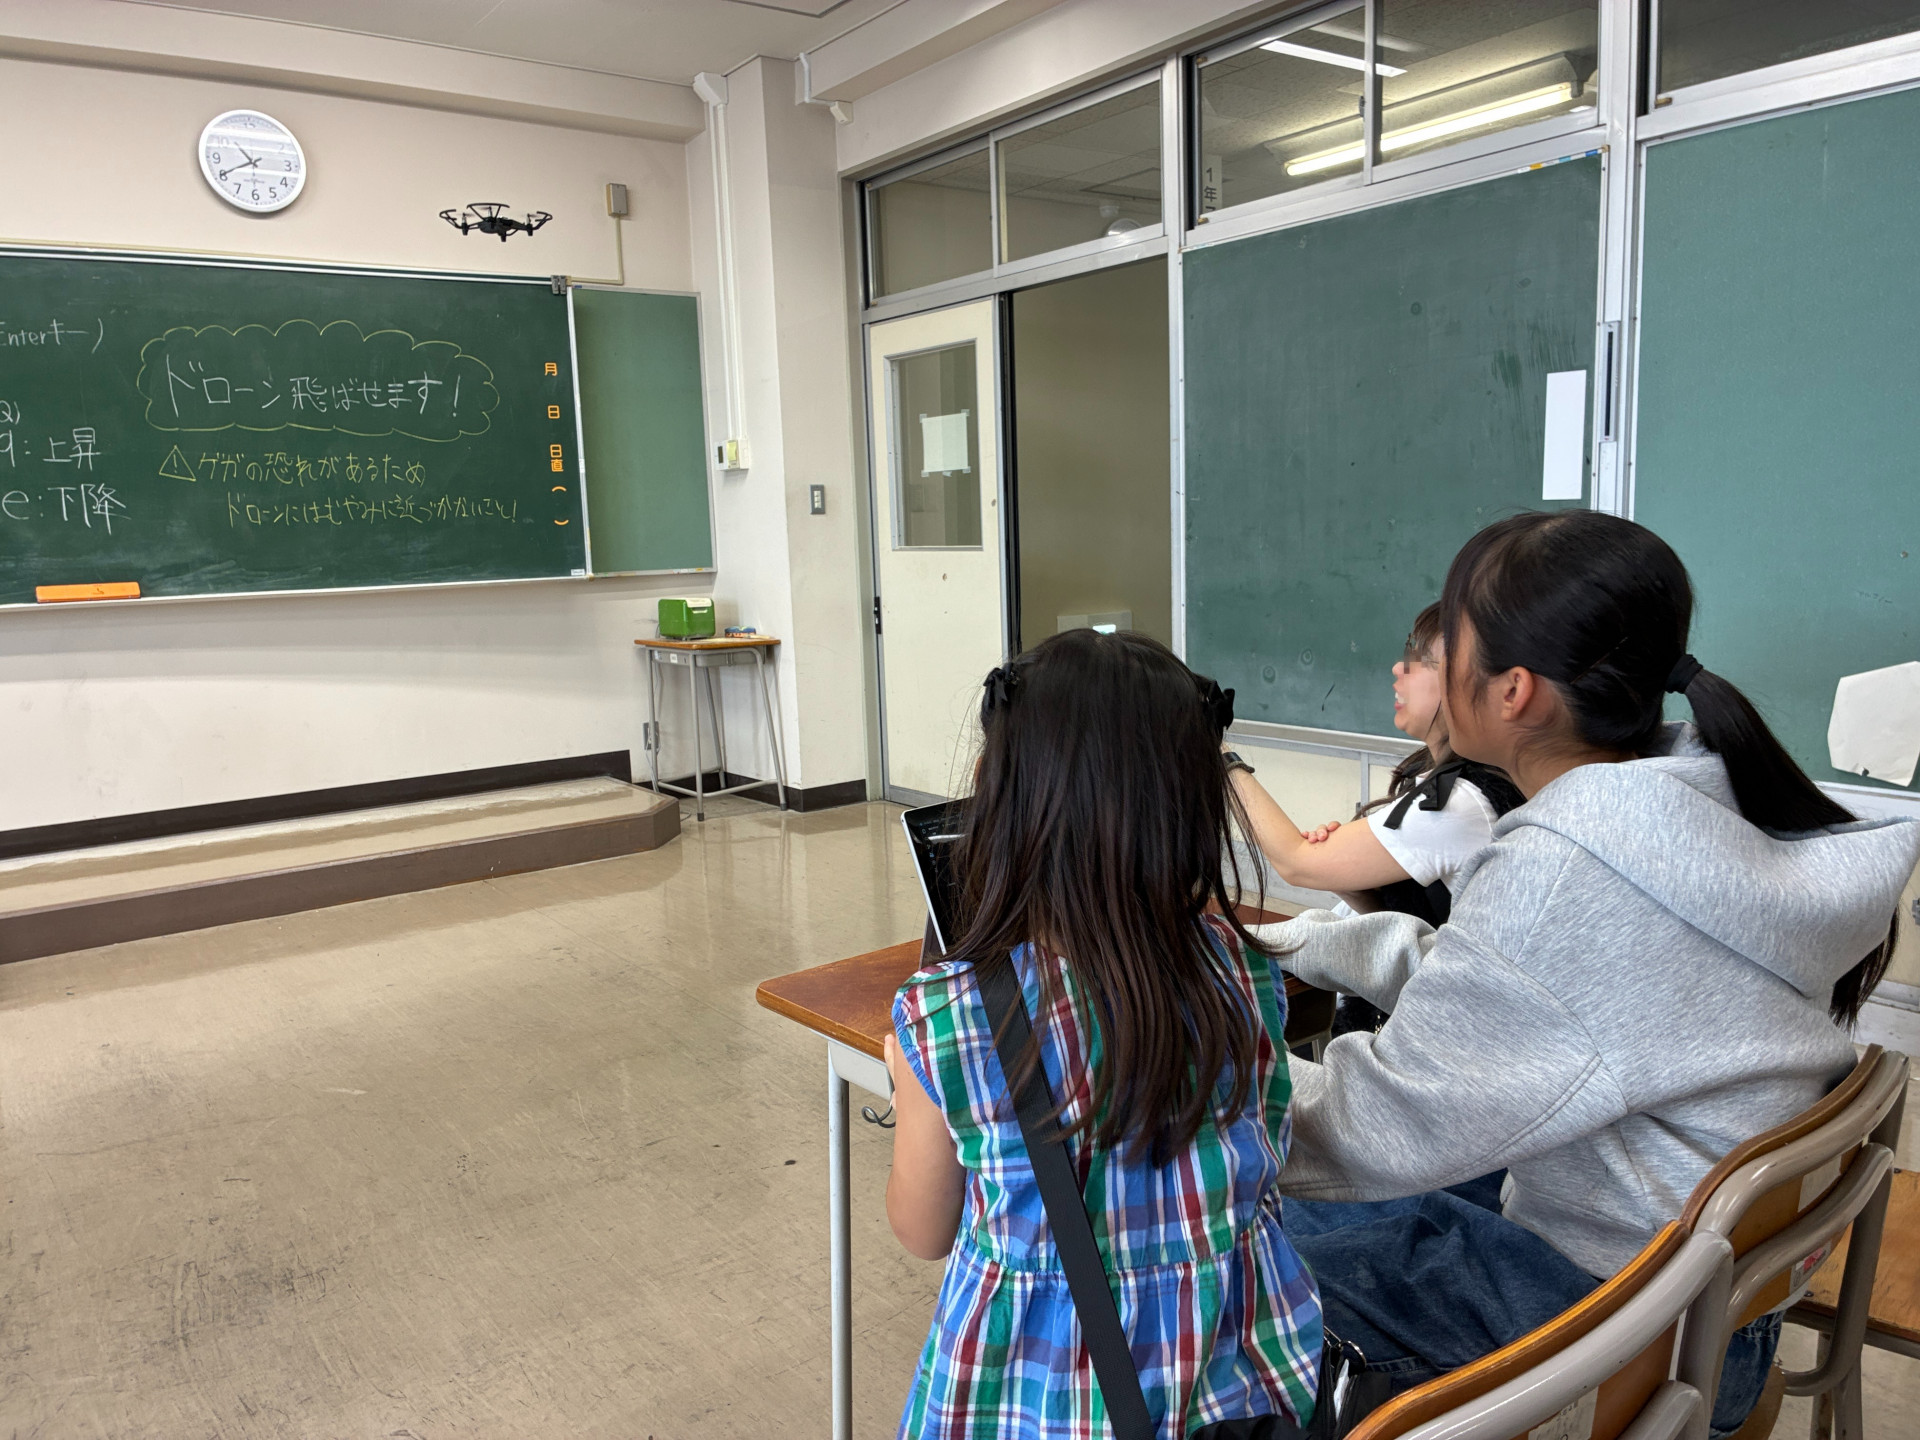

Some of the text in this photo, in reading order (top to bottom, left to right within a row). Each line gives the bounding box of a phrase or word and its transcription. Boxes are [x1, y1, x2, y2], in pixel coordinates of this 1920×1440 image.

[212, 152, 221, 164] 9
[284, 160, 292, 172] 3
[219, 169, 228, 181] 8
[280, 176, 289, 188] 4
[233, 183, 241, 194] 7
[251, 189, 260, 200] 6
[269, 187, 277, 199] 5
[545, 362, 558, 376] 月
[547, 405, 560, 419] 日
